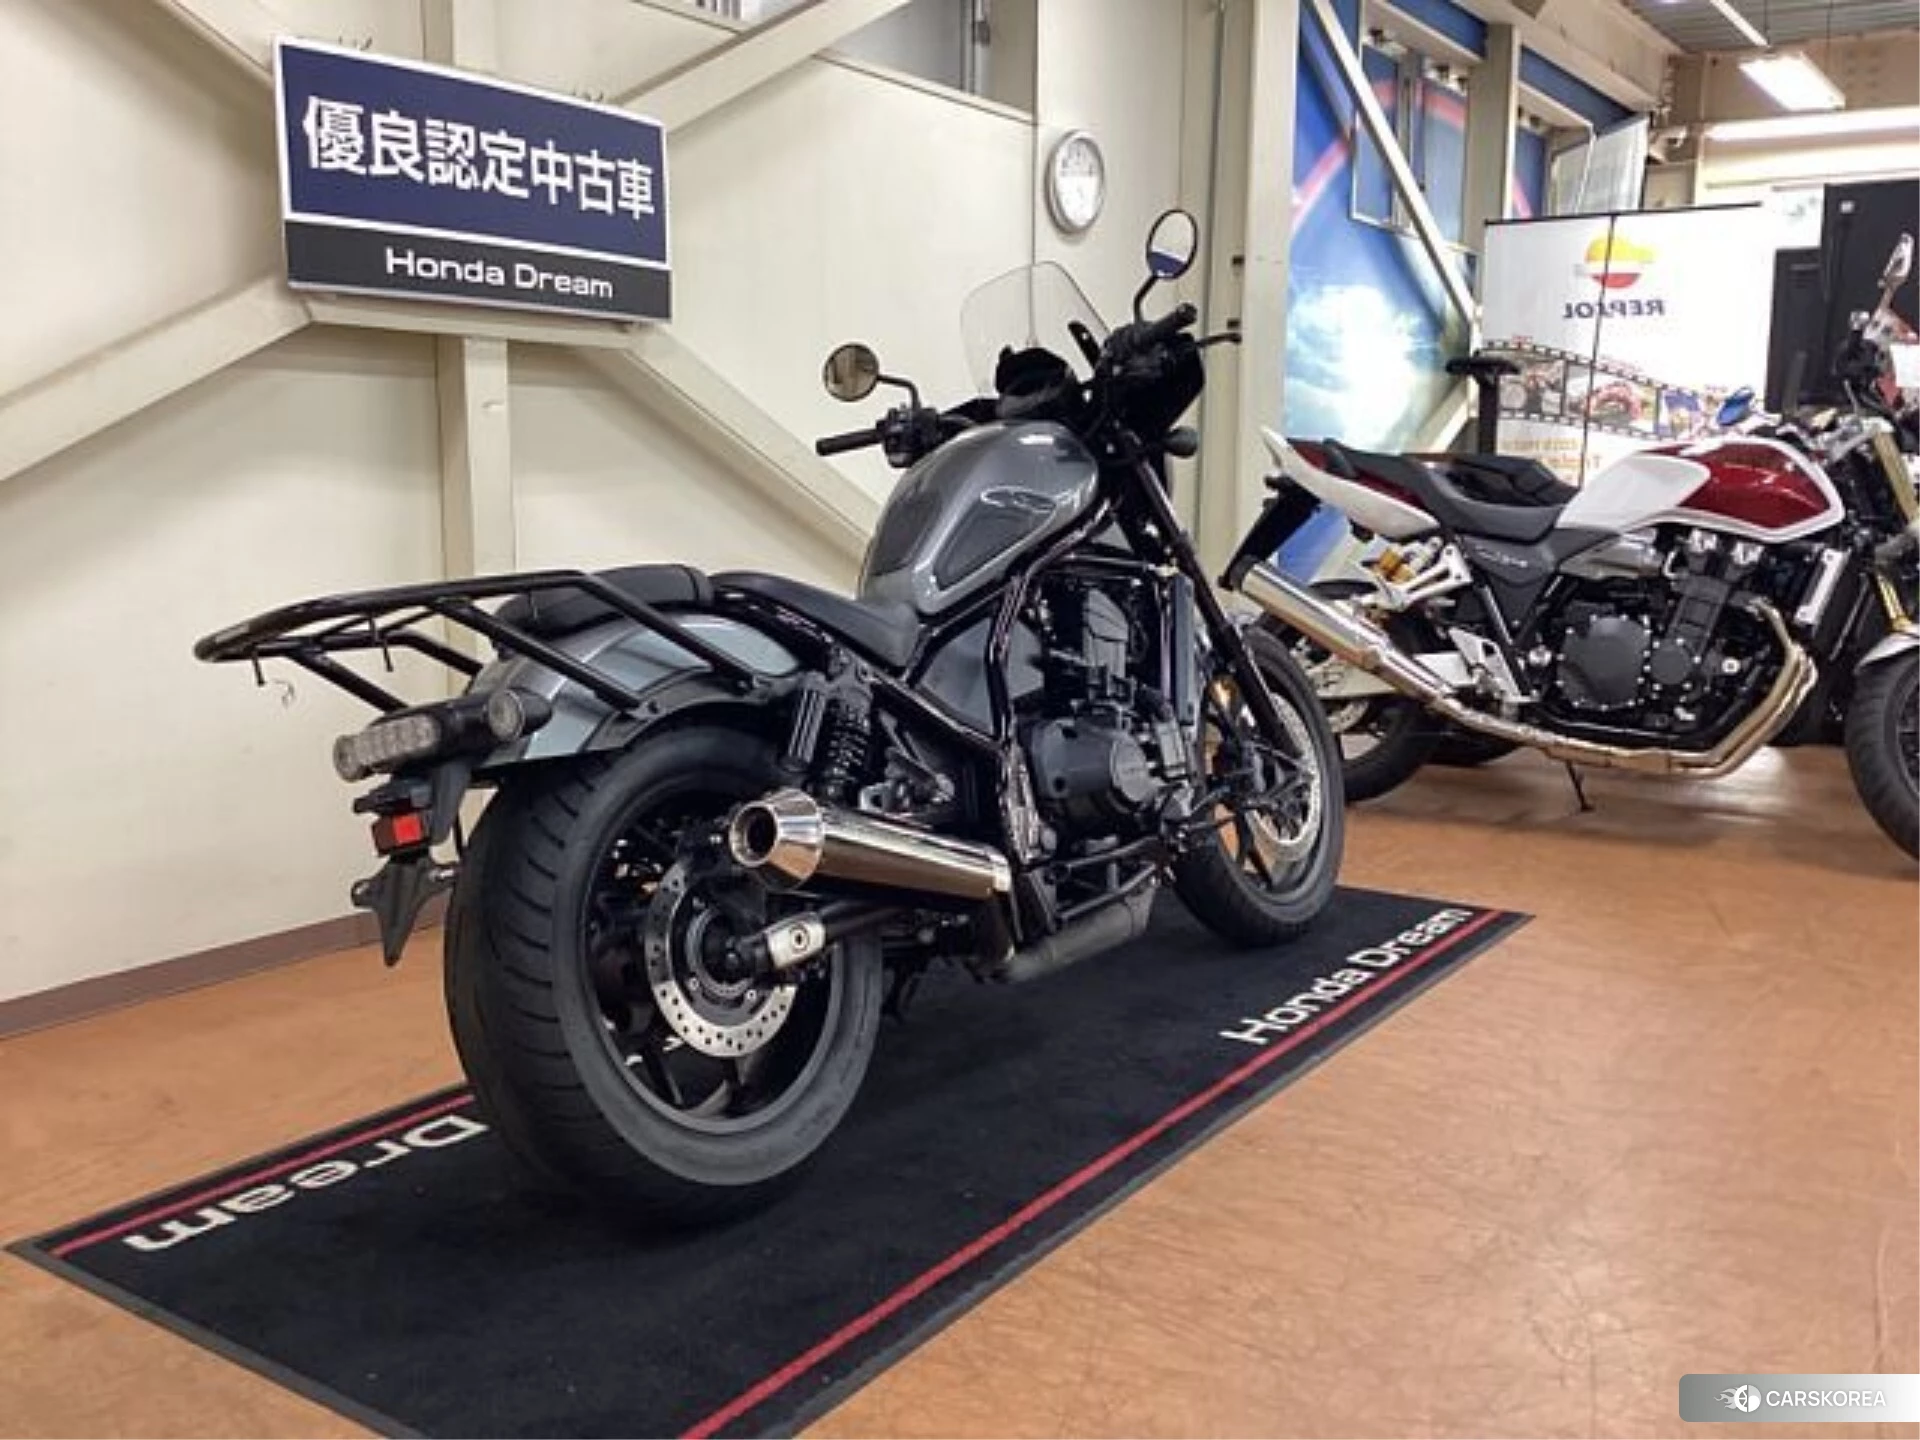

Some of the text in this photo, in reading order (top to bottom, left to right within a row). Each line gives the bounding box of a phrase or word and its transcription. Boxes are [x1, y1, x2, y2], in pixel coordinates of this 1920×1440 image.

[302, 95, 656, 221] 優良認定中古車
[385, 246, 614, 299] Honda Dream
[1218, 907, 1474, 1046] Honda Dream
[121, 1113, 490, 1252] Dream
